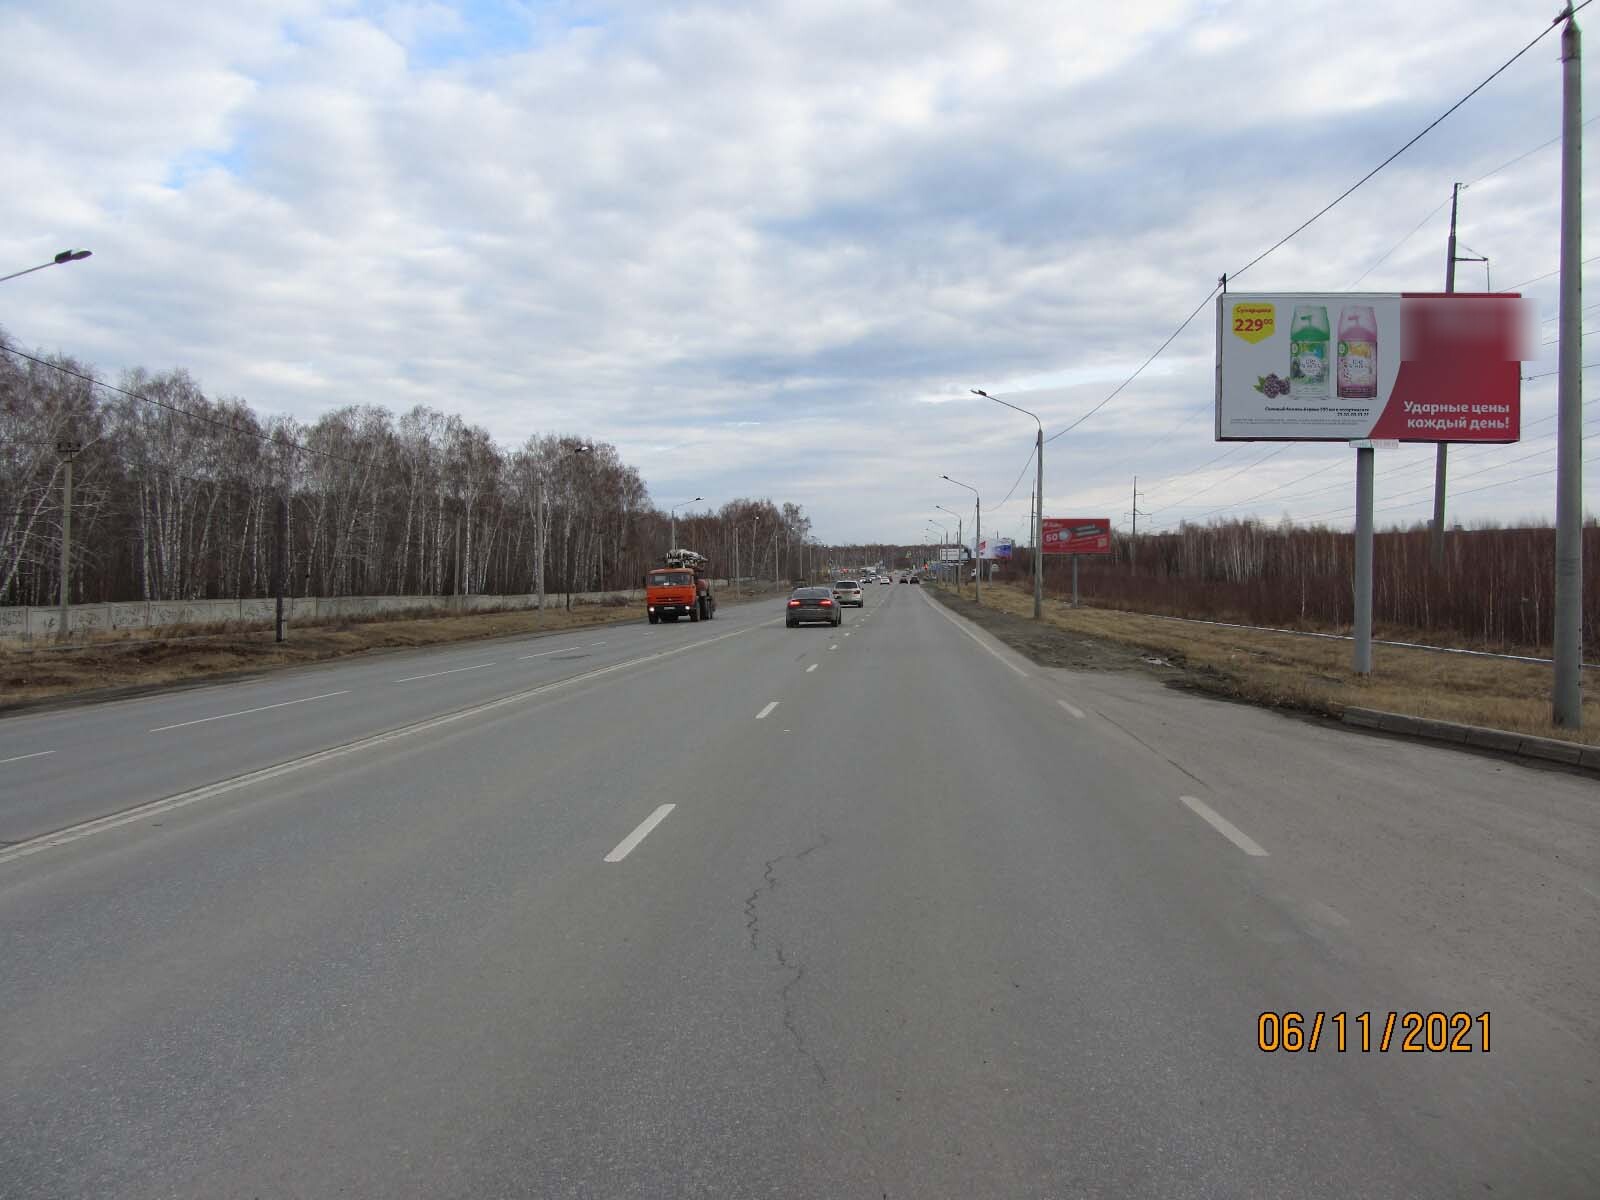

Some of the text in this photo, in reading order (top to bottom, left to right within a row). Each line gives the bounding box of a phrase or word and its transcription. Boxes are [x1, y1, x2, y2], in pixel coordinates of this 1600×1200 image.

[1403, 400, 1510, 416] Ударные цены
[1407, 416, 1510, 431] каждый день!
